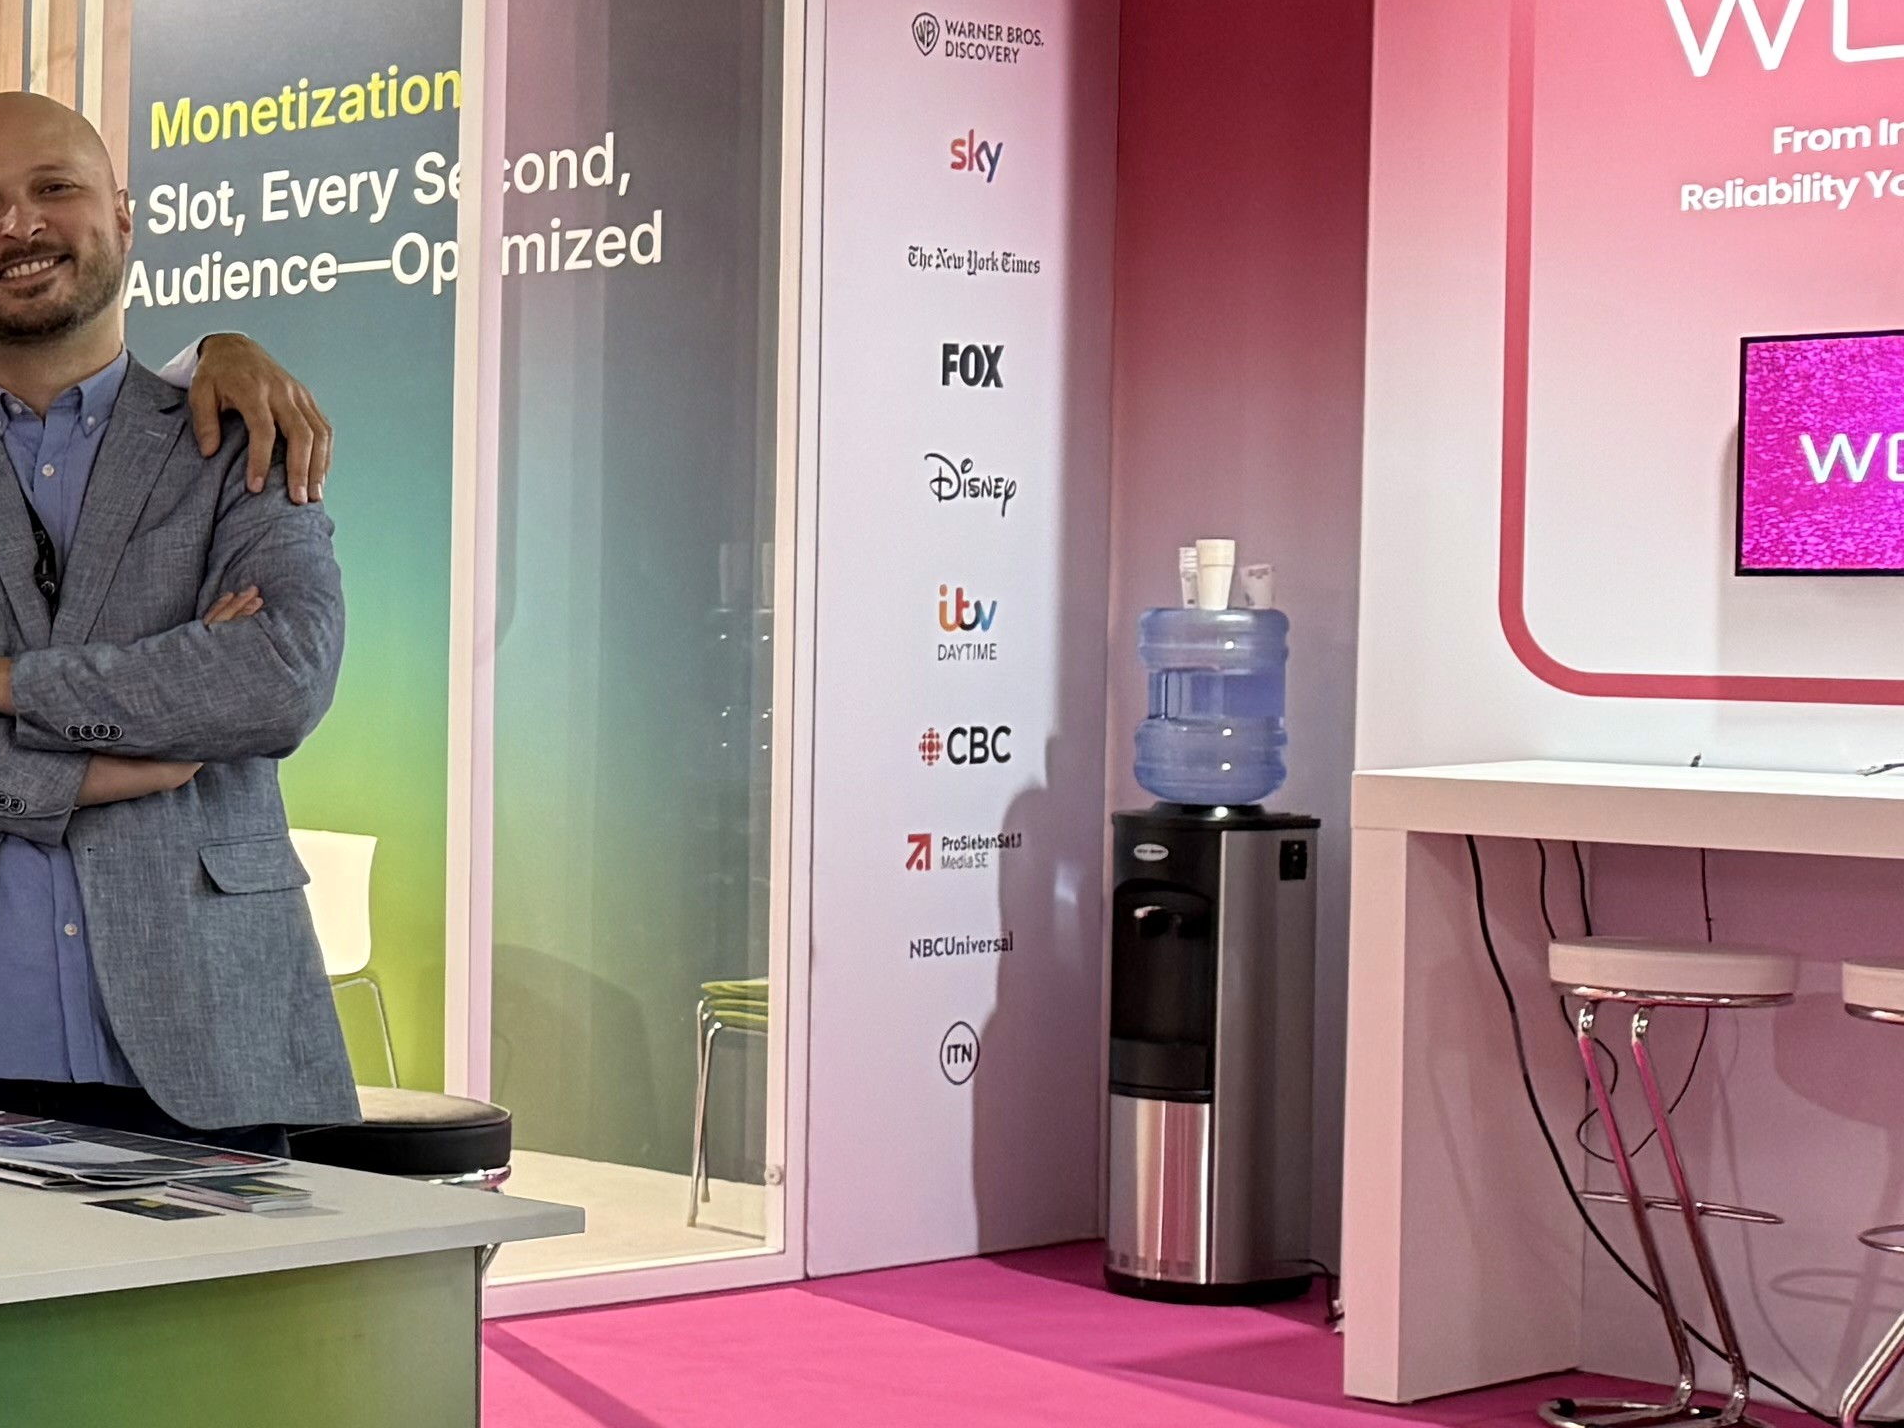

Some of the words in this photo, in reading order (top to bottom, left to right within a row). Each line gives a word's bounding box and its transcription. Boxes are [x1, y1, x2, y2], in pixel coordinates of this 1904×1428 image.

[945, 19, 1003, 42] WARNER
[1007, 26, 1044, 47] BROS.
[945, 40, 1020, 64] DISCOVERY
[150, 64, 461, 150] Monetization
[950, 129, 1003, 183] sky
[1773, 125, 1871, 155] From
[148, 180, 246, 238] Slot,
[262, 162, 398, 223] Every
[414, 132, 631, 205] Sond,
[1680, 171, 1860, 211] Reliability
[908, 245, 933, 271] The
[935, 247, 965, 270] New
[967, 249, 999, 276] York
[1001, 251, 1041, 274] Times
[942, 342, 1004, 388] FOX
[1799, 432, 1904, 483] W
[938, 584, 998, 633] itv
[937, 643, 997, 662] DAYTIME
[946, 725, 1012, 765] CBC
[941, 854, 973, 870] Media
[975, 852, 989, 868] SE
[909, 930, 1014, 959] NBCUniversal
[946, 1043, 973, 1064] ITN
